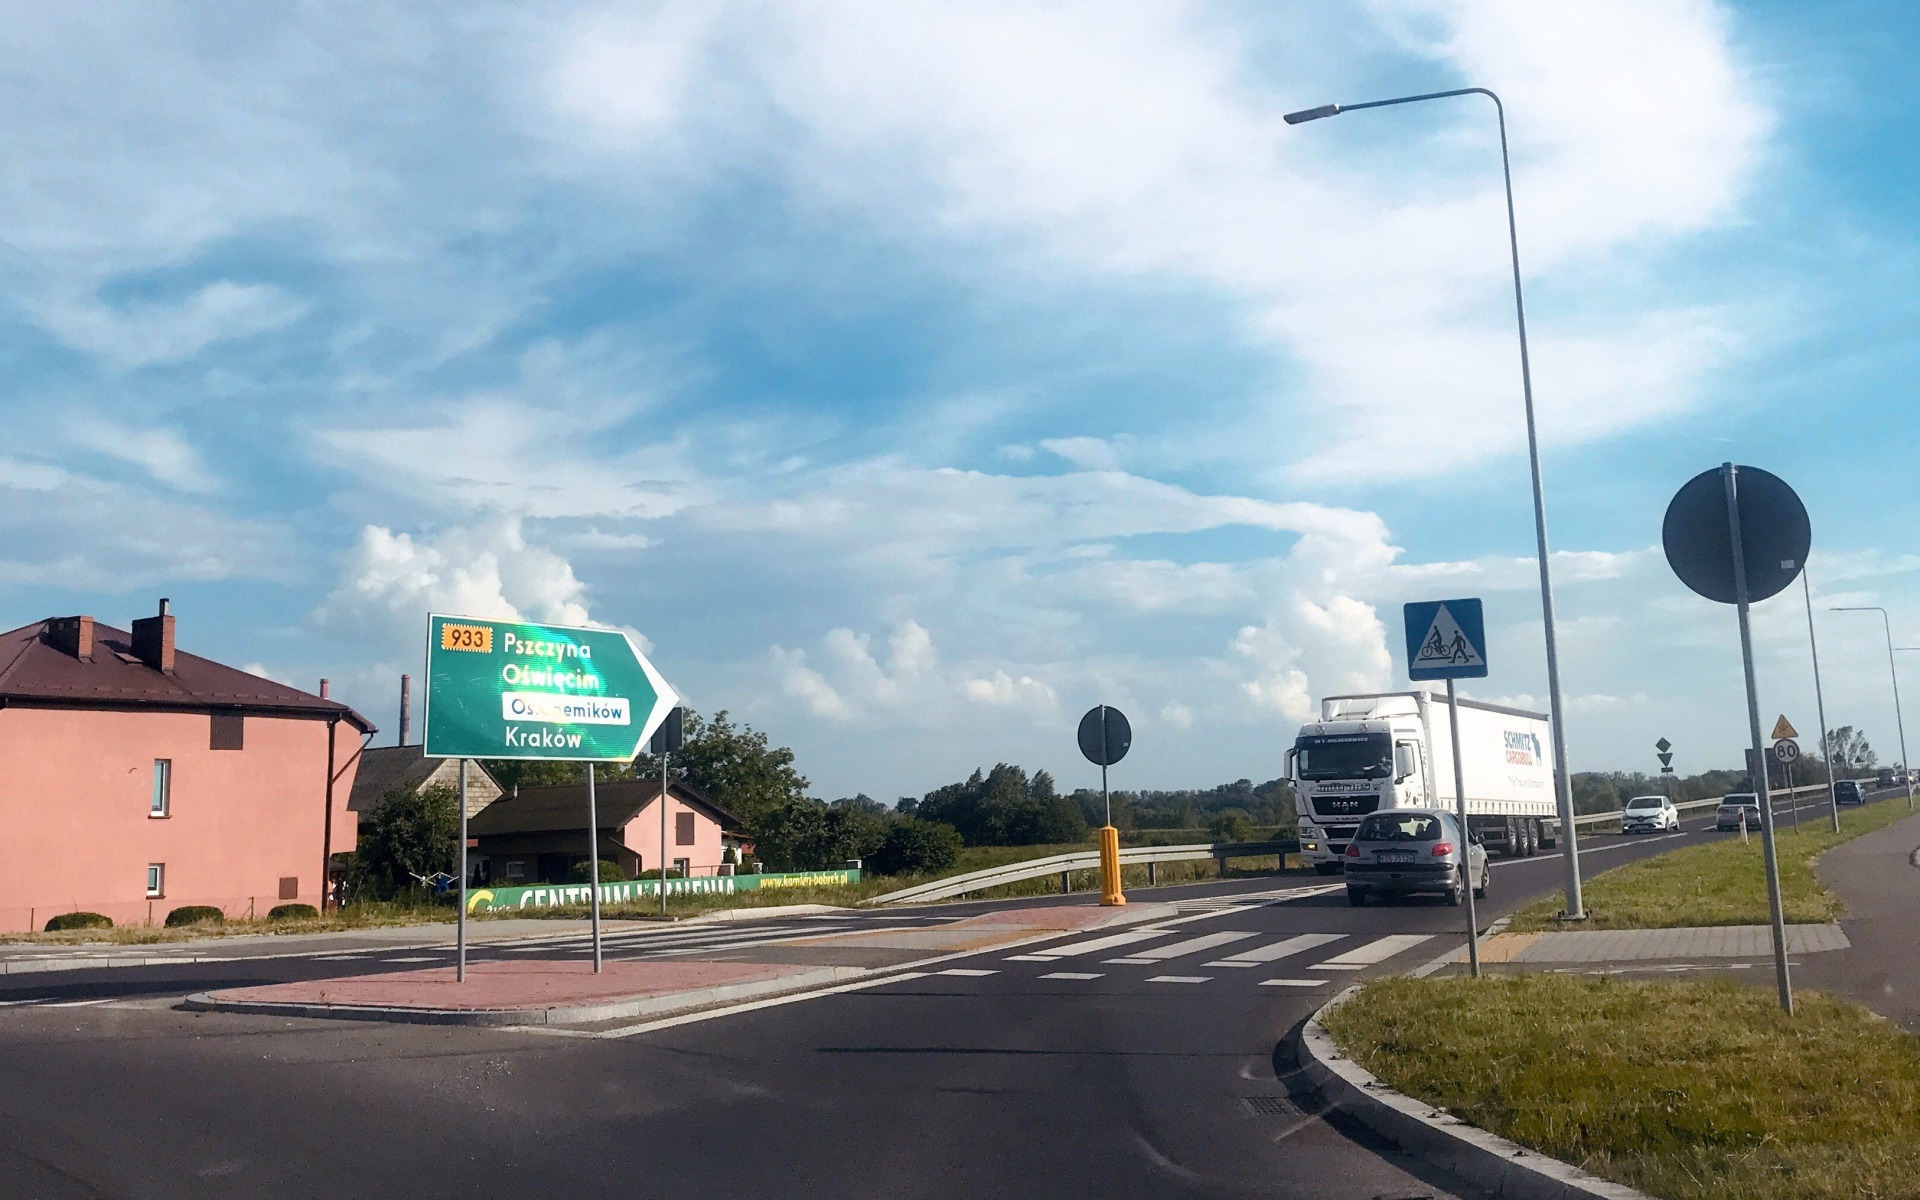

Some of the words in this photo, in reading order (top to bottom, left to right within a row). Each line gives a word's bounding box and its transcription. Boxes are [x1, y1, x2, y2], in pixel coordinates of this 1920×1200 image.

[452, 629, 484, 648] 933
[504, 633, 592, 662] Pszczyna
[503, 663, 600, 691] Oświęcim
[505, 726, 582, 748] Kraków
[1503, 730, 1531, 751] SCHMITZ
[1777, 745, 1796, 758] 80
